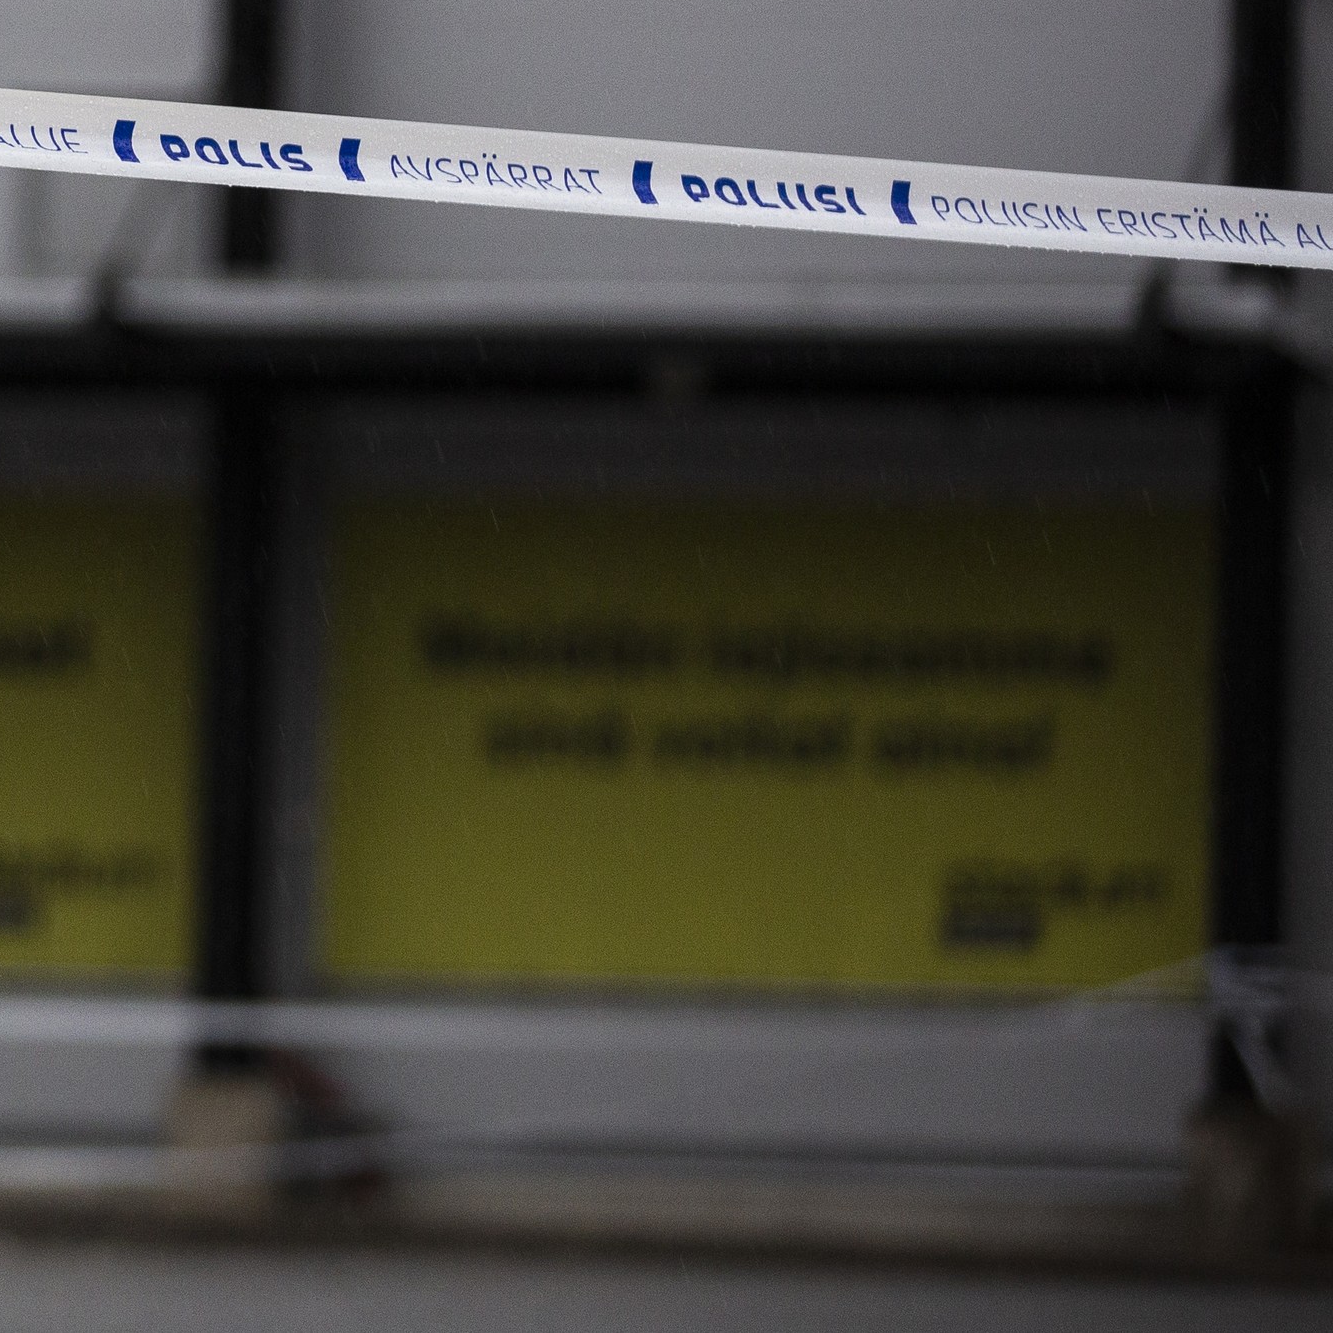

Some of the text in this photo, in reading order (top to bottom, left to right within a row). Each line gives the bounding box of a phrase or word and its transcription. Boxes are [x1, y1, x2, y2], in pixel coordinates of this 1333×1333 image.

[160, 133, 314, 173] POLIS
[390, 153, 601, 195] AVSPÄRRAT
[681, 174, 867, 216] POLIISI
[931, 195, 1089, 232] POLIISIN
[1096, 207, 1286, 247] ERISTÄMÄ
